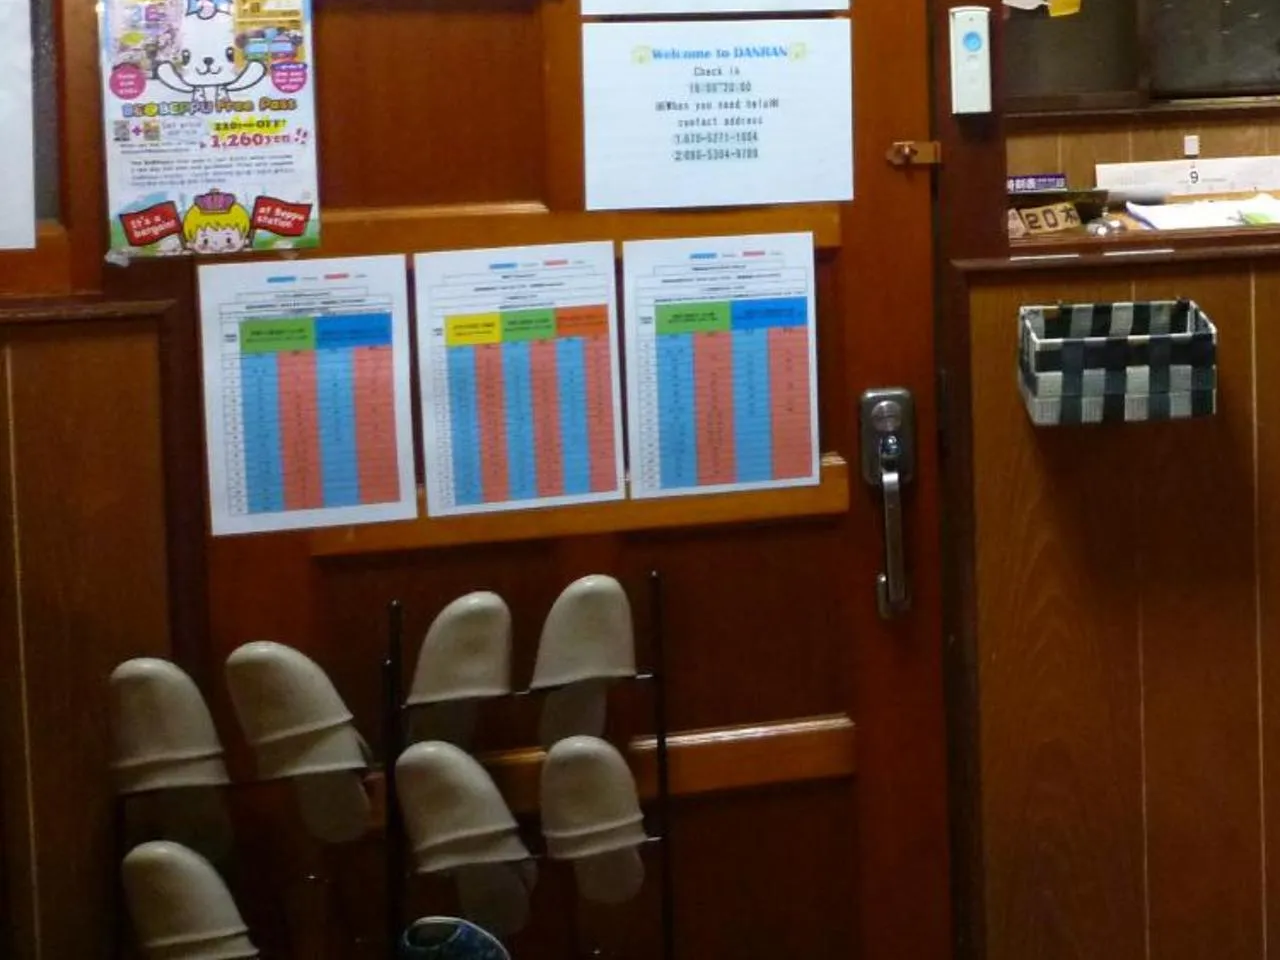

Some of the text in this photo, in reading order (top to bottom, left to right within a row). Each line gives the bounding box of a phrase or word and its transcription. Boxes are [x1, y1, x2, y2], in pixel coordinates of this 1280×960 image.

[651, 45, 788, 61] Welcome to DANRAN
[693, 66, 723, 77] Check
[215, 98, 255, 116] Free
[258, 96, 298, 113] Pass
[1190, 170, 1199, 184] 9
[273, 207, 306, 223] Beppu
